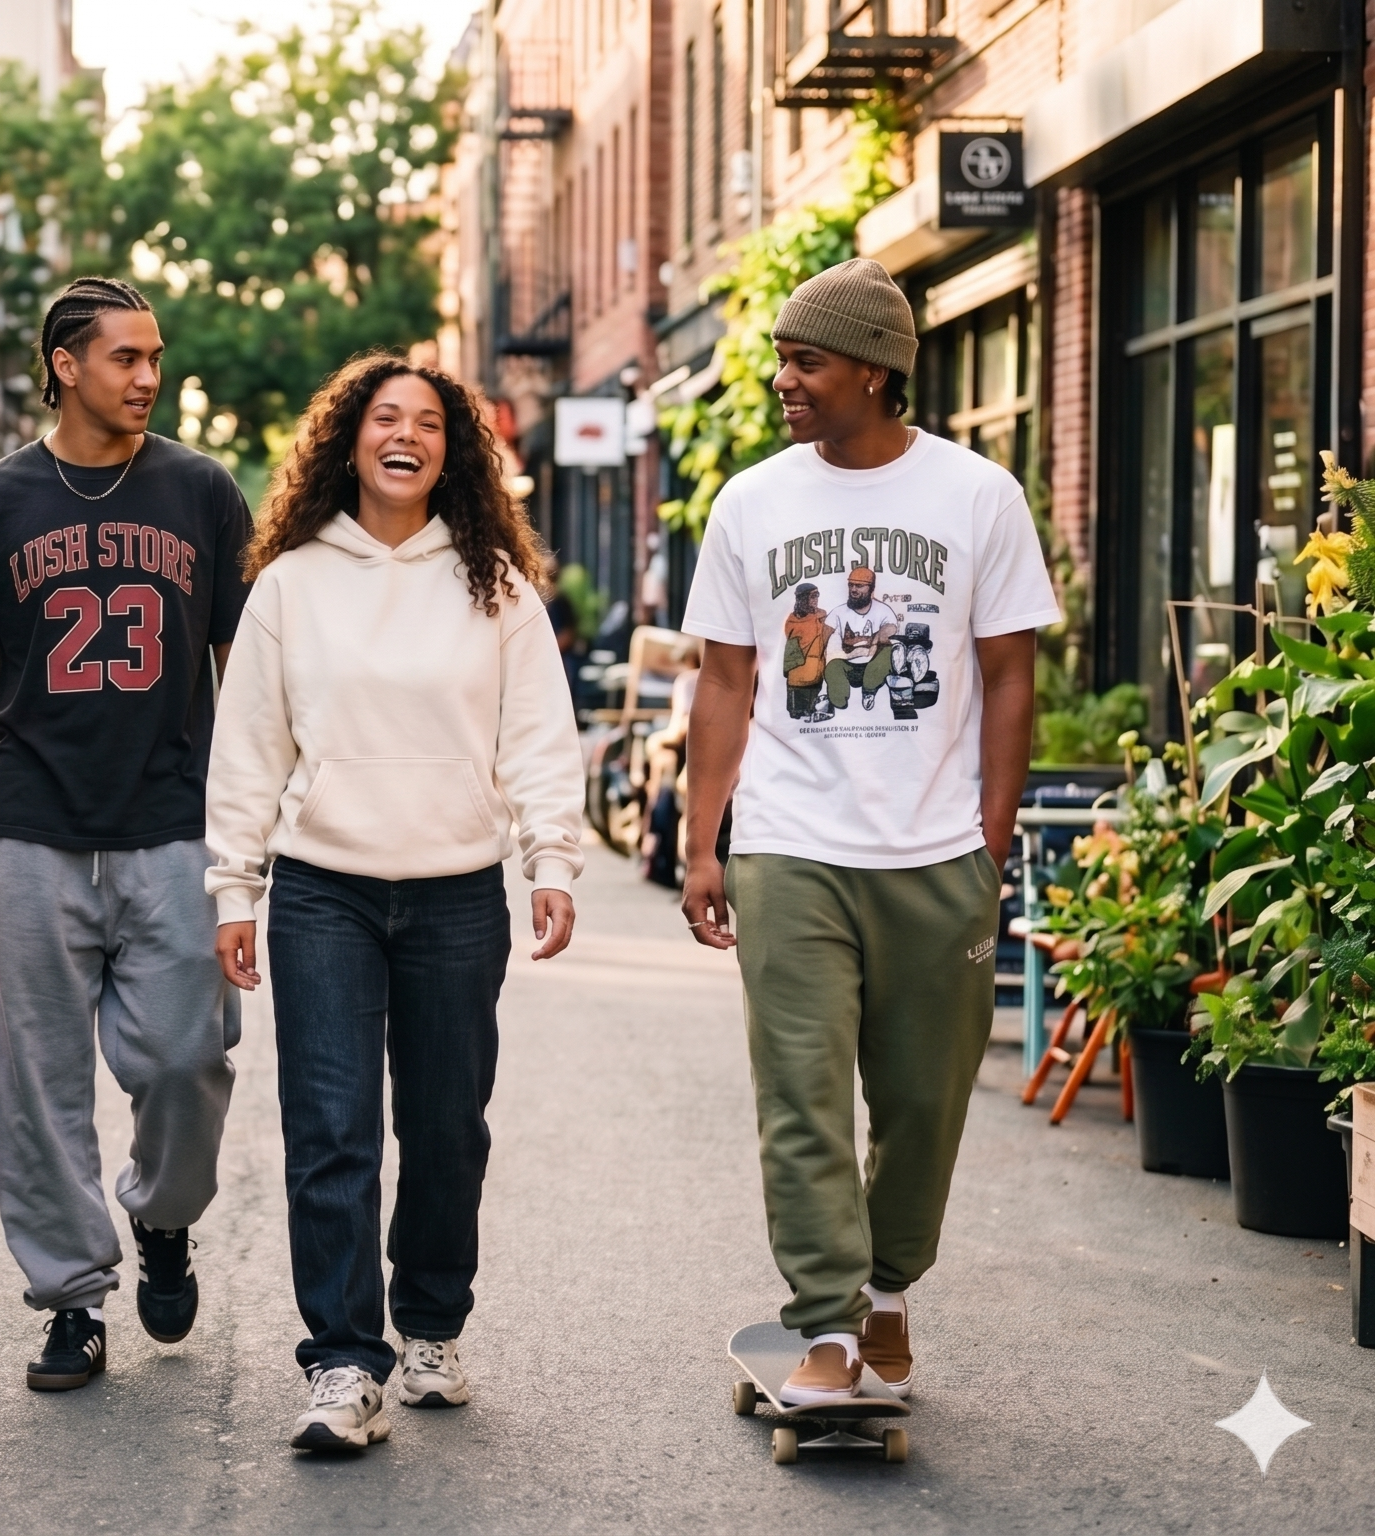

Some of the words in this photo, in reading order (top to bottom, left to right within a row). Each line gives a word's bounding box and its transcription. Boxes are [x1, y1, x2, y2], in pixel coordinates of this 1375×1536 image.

[9, 523, 89, 603] LUSH
[97, 522, 196, 596] STORE
[767, 527, 846, 600] LUSH
[850, 526, 948, 596] STORE
[44, 584, 163, 694] 23
